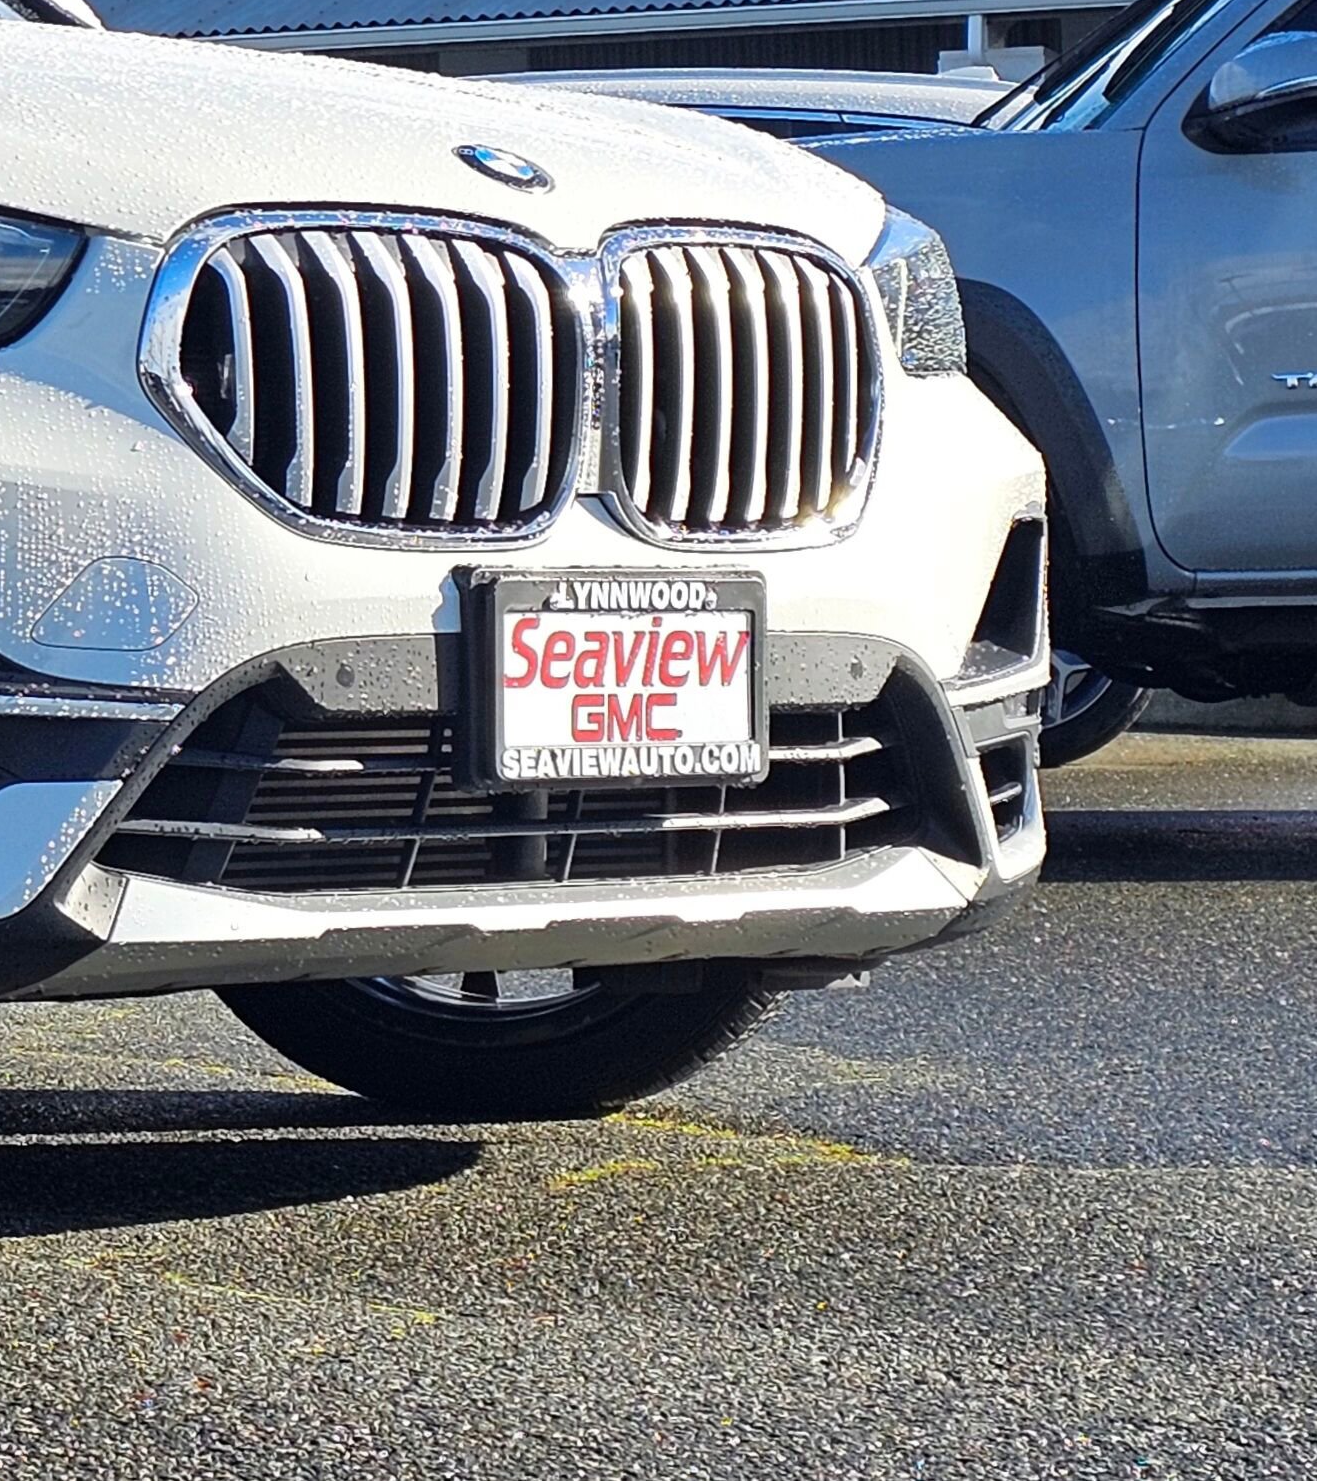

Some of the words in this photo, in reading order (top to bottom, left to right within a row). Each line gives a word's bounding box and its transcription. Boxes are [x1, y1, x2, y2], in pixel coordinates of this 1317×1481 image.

[556, 581, 708, 610] LYNNWOOD
[502, 616, 750, 689] Seaview
[571, 692, 682, 742] GMC
[500, 744, 762, 779] SEAVIEWAUTO.COM
